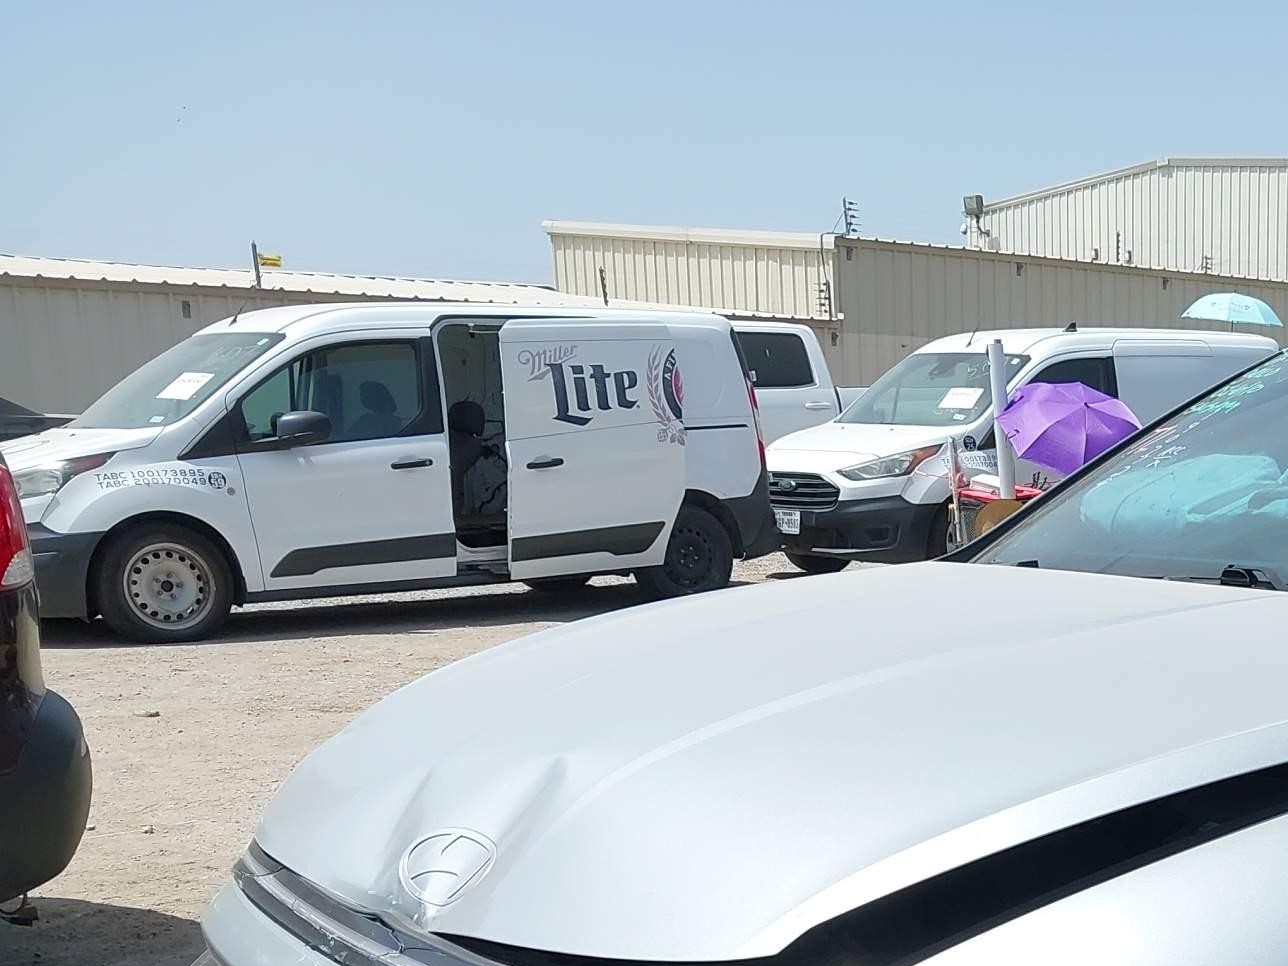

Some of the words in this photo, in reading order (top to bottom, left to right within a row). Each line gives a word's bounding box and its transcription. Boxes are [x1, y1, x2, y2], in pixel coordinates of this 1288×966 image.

[518, 345, 577, 382] Miller
[545, 363, 640, 427] Lite
[94, 471, 127, 481] TABC
[131, 468, 205, 478] 100173895
[97, 479, 130, 489] TABC
